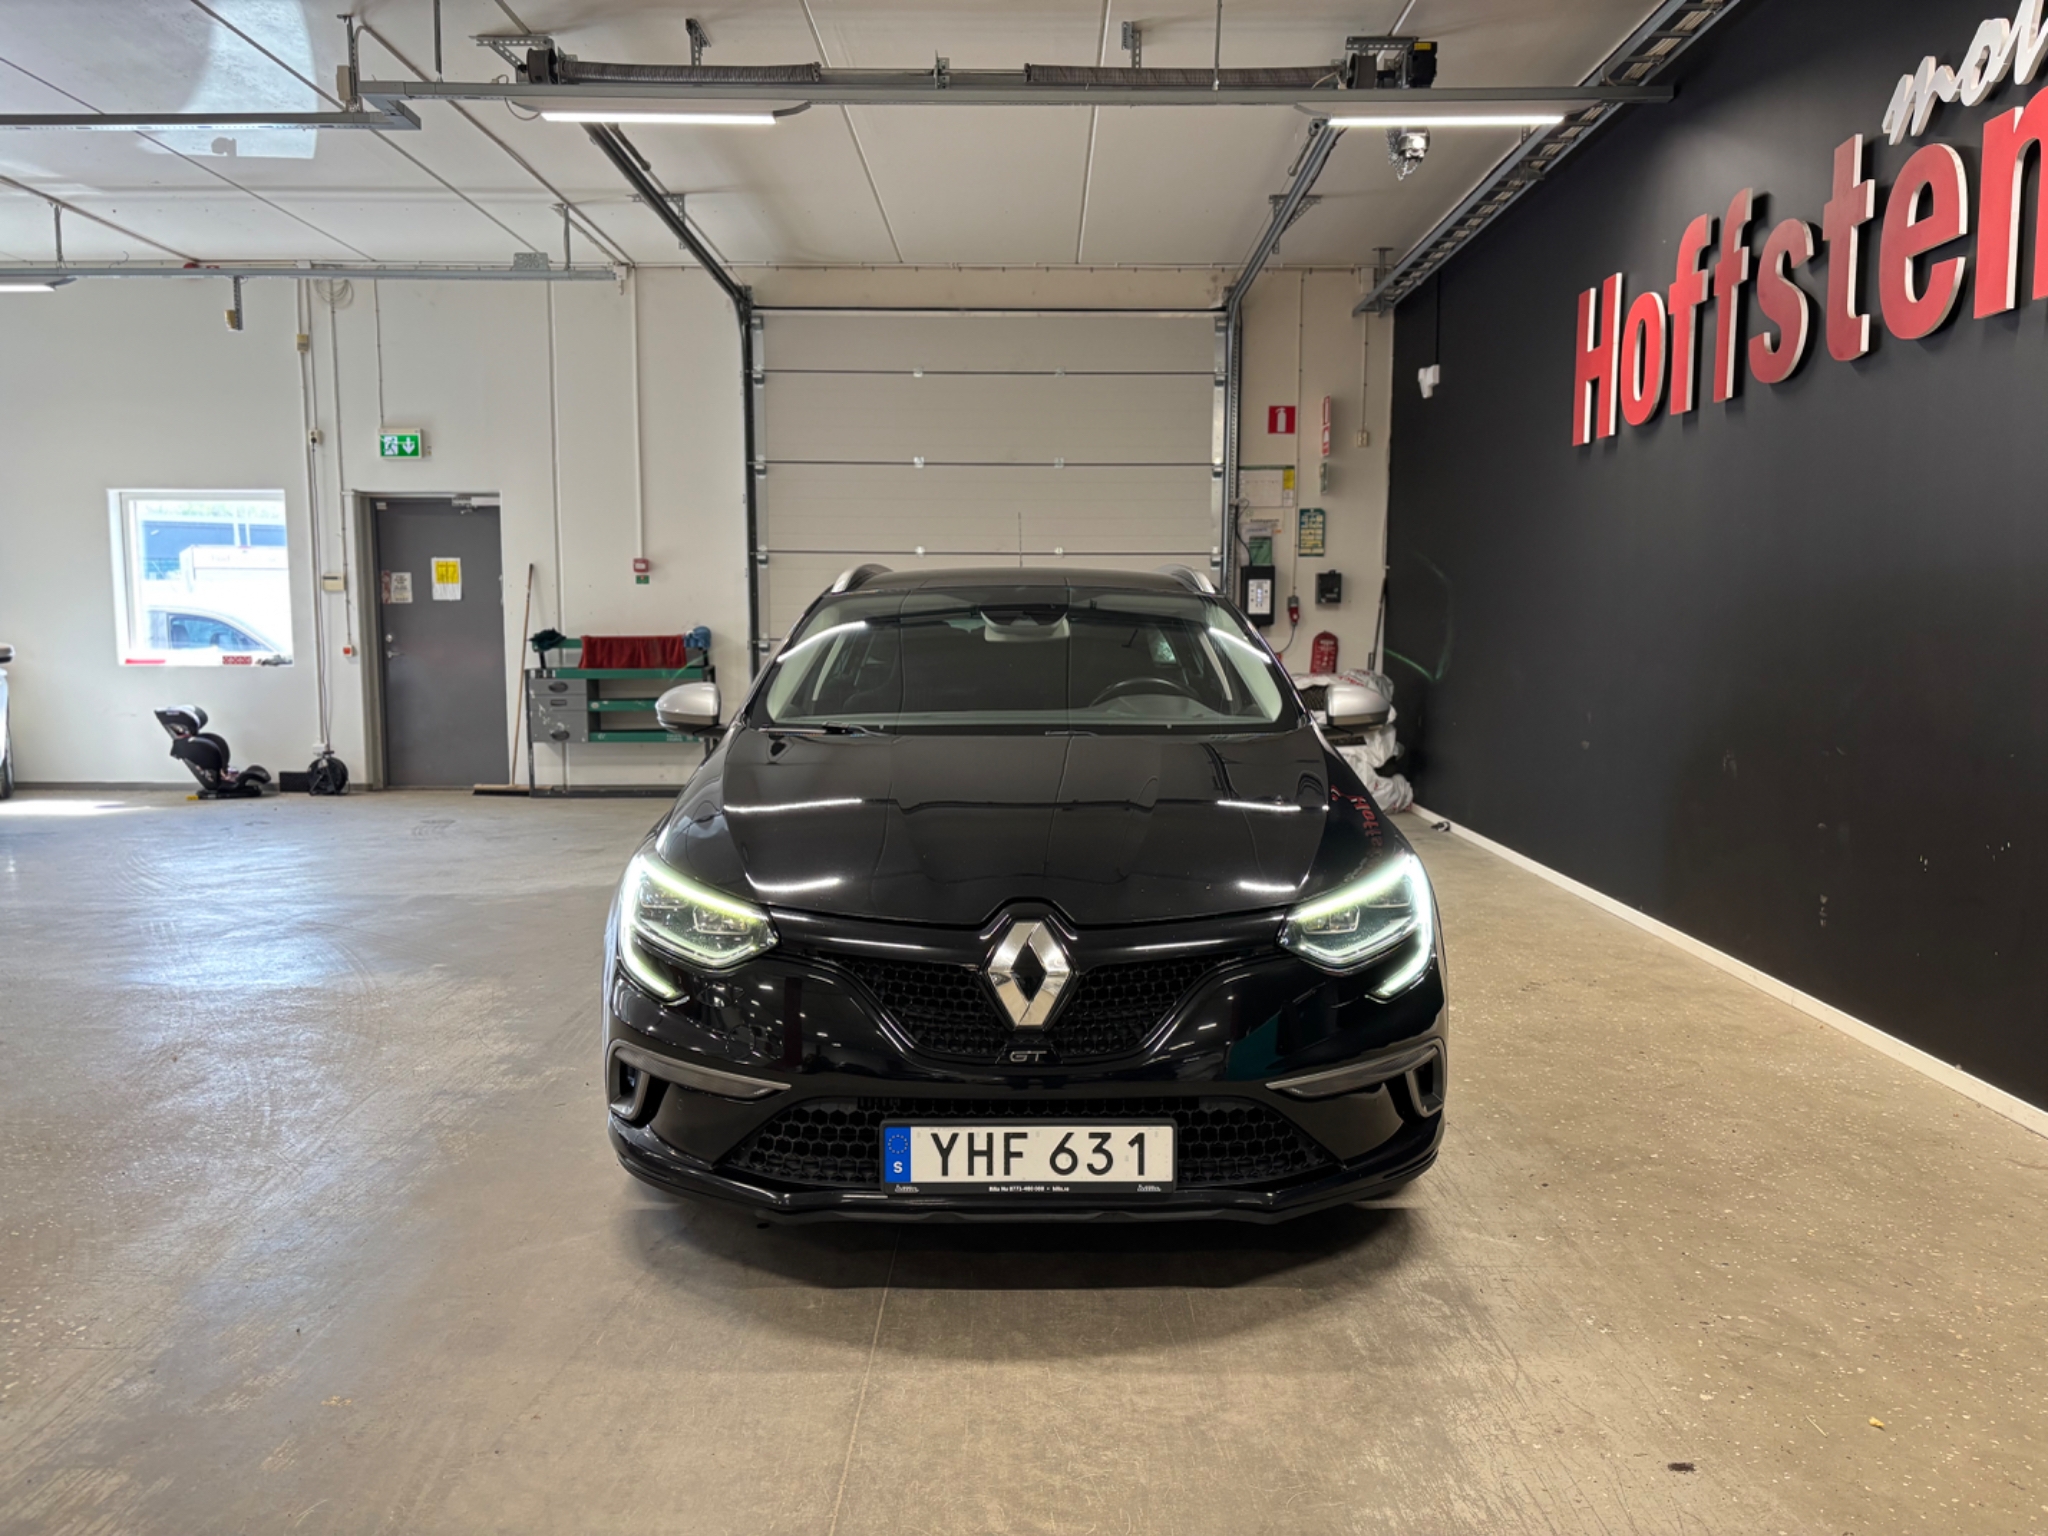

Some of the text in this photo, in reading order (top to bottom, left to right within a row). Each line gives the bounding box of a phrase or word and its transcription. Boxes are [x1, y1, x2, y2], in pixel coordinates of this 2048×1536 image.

[1009, 1050, 1047, 1063] GT
[931, 1132, 1146, 1176] YHF 631
[893, 1161, 903, 1174] S
